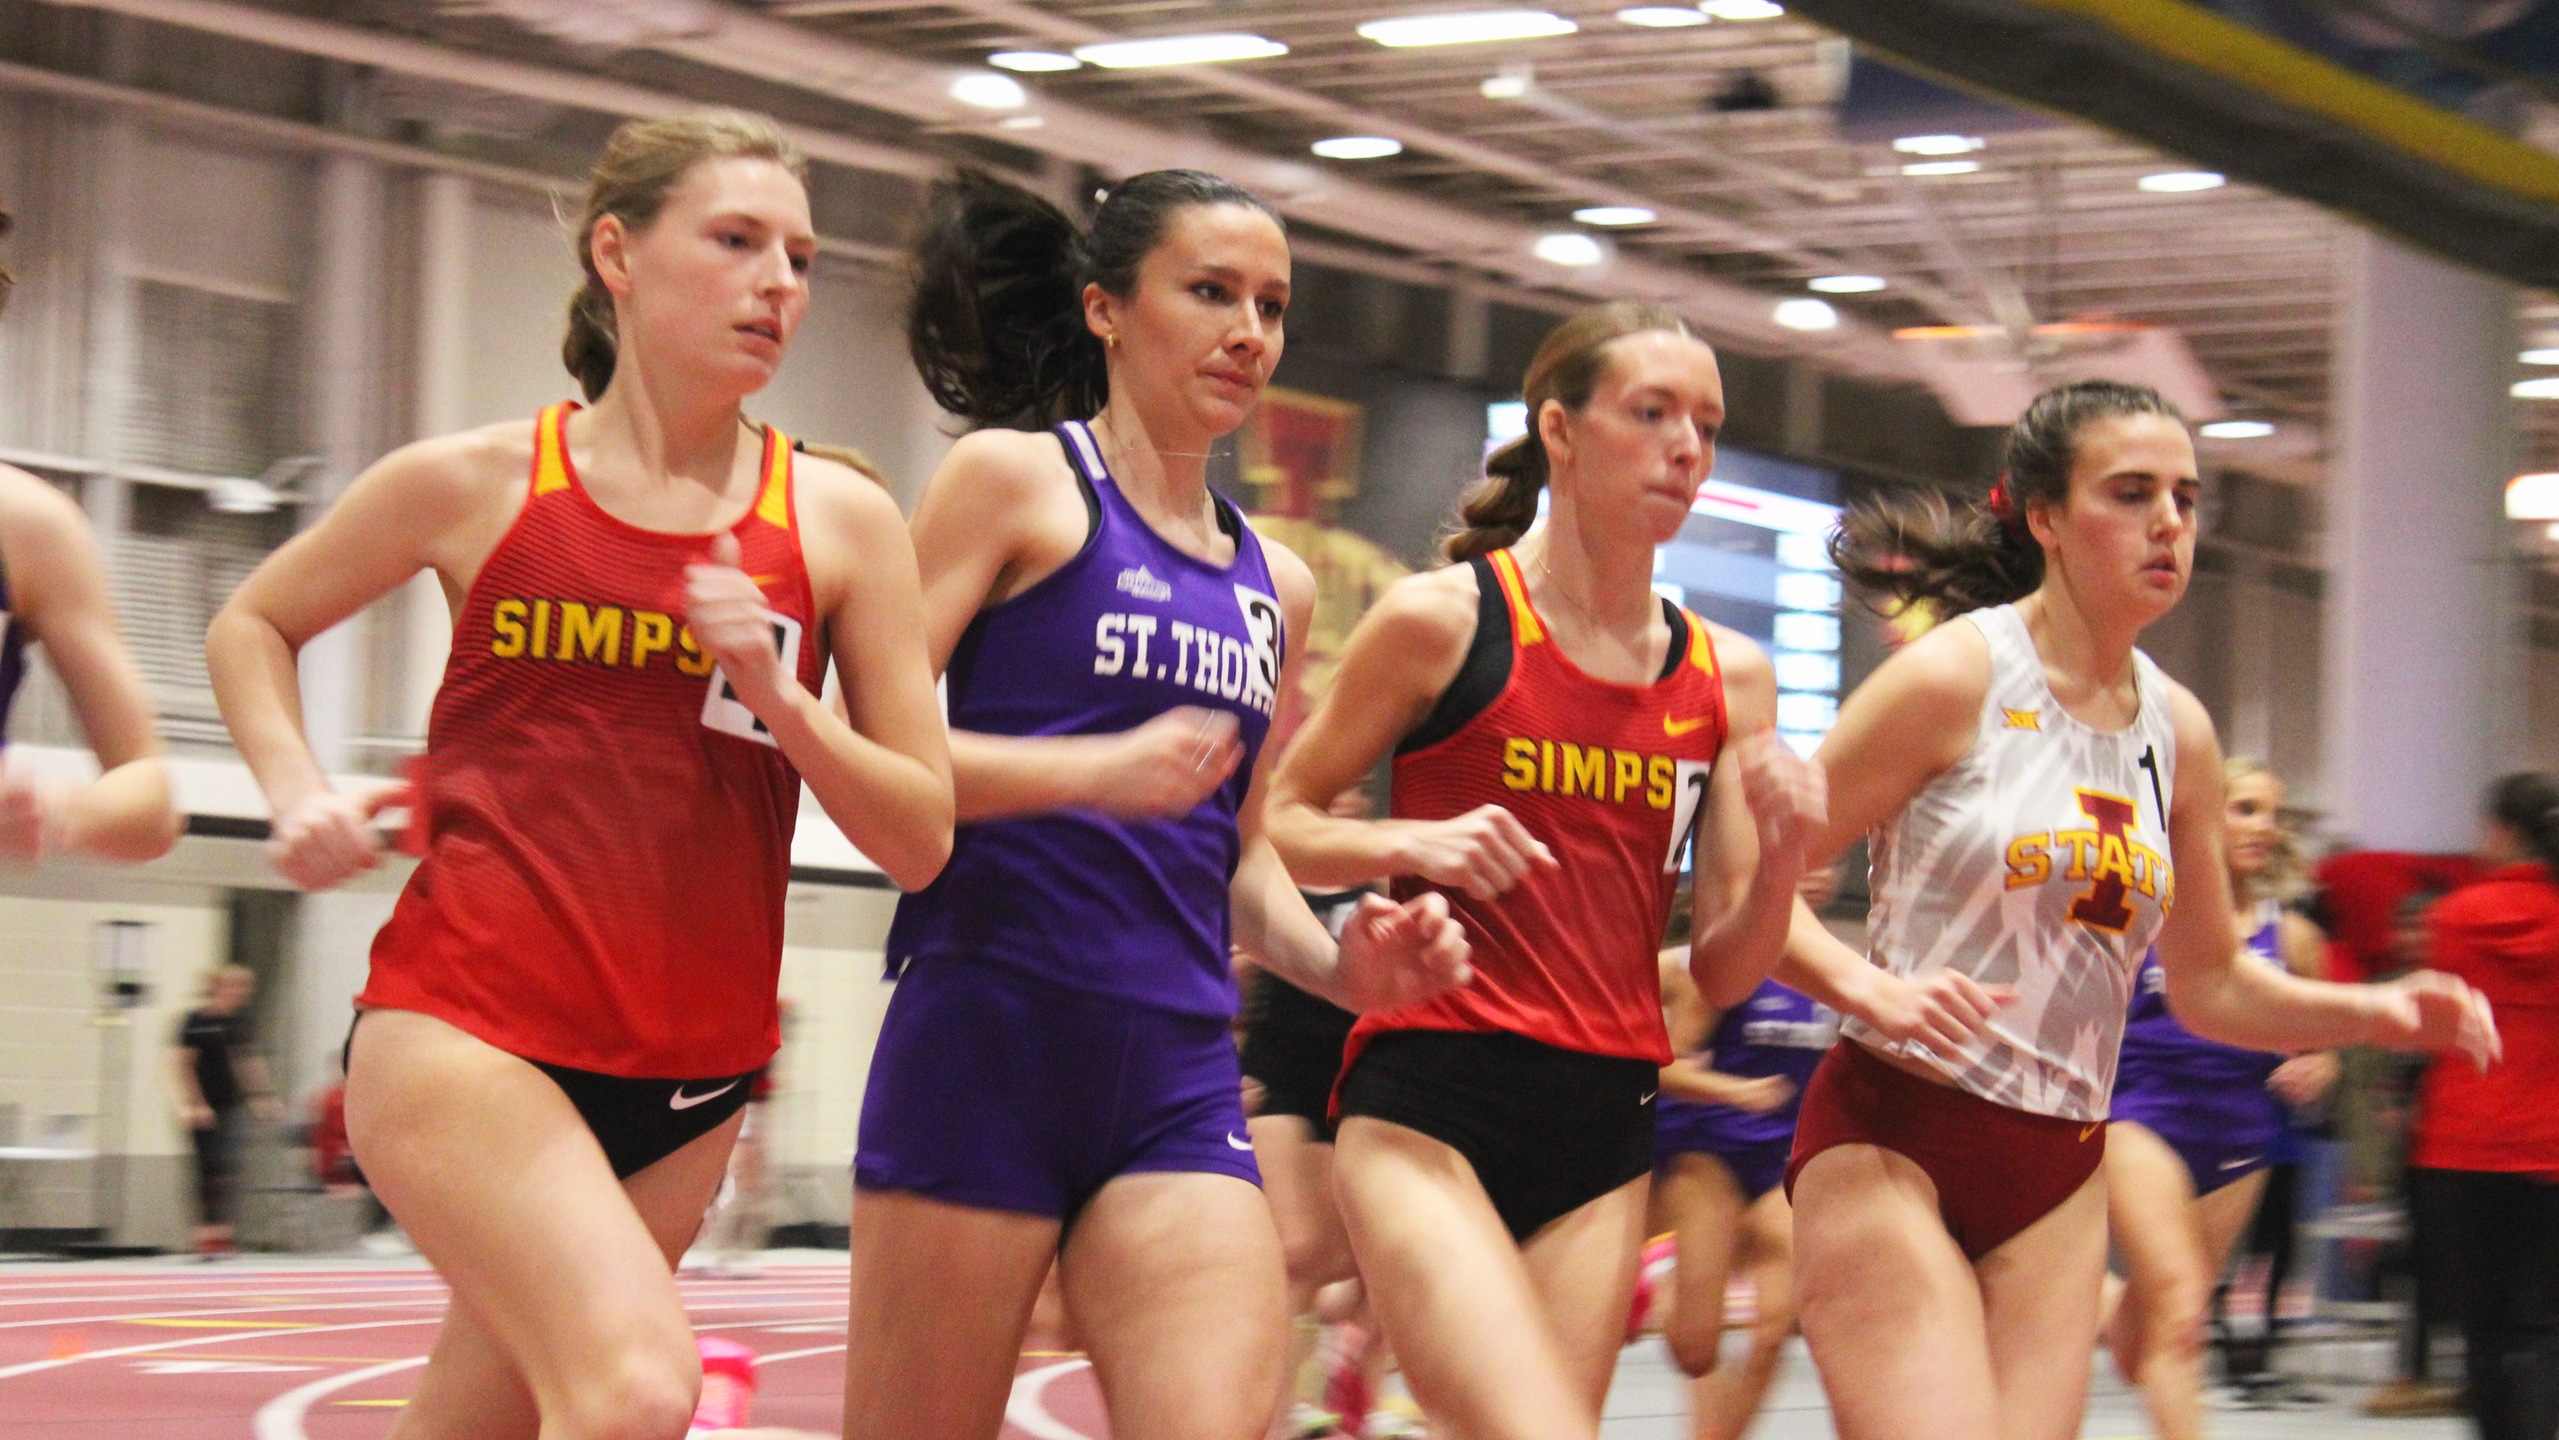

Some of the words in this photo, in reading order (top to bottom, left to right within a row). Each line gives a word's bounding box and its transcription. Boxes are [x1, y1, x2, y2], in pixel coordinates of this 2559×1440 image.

[1094, 612, 1277, 720] ST.THO
[1250, 601, 1279, 694] 3
[1502, 736, 1675, 811] SIMPS
[2138, 744, 2167, 834] 1
